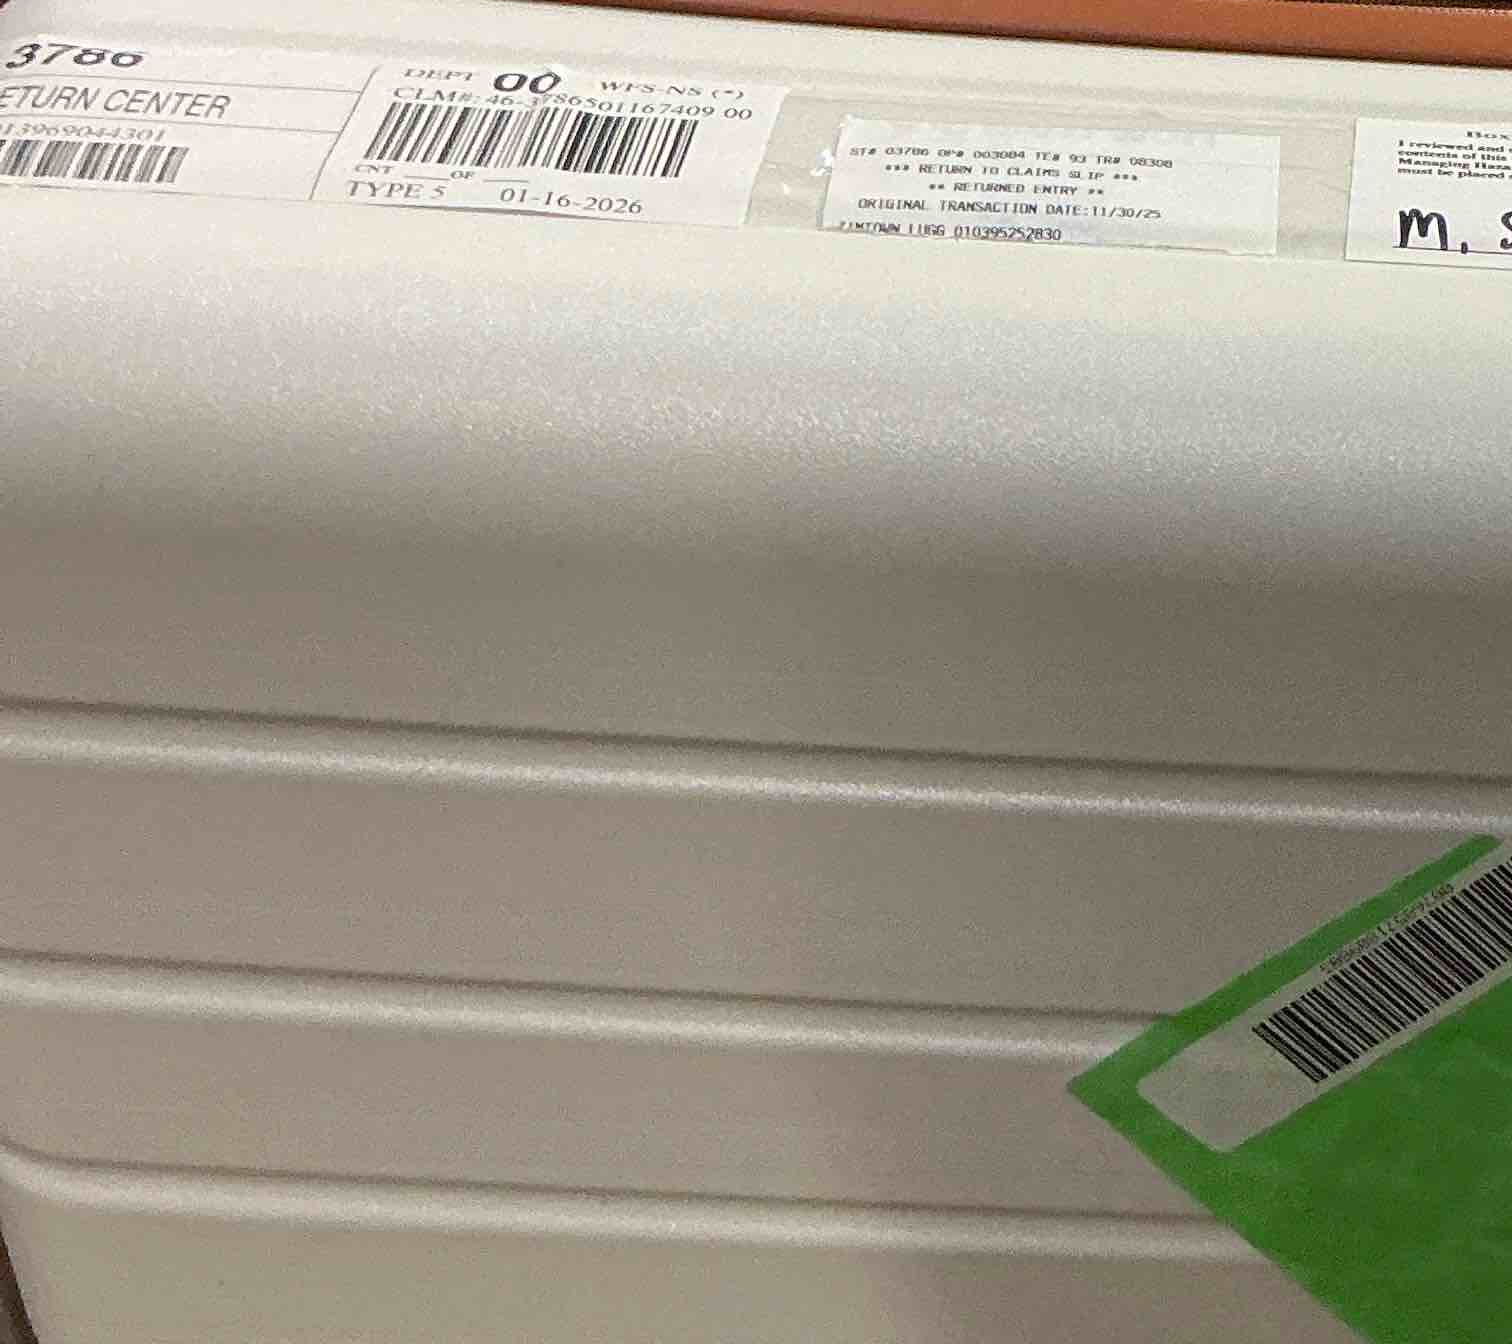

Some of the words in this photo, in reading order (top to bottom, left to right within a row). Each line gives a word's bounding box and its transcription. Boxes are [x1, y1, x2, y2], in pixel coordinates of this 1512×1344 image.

[5, 42, 147, 69] 3786
[403, 68, 474, 81] DEPT
[493, 71, 561, 94] 00
[0, 85, 100, 112] ETURN
[103, 89, 231, 119] CENTER
[724, 107, 753, 120] 00
[1409, 142, 1473, 151] reviewed
[1478, 145, 1504, 153] and
[1398, 150, 1458, 158] contents
[1462, 152, 1477, 160] of
[1481, 154, 1507, 162] this
[1399, 158, 1471, 169] Managing
[355, 164, 394, 176] CNT
[450, 171, 476, 180] OF
[919, 164, 972, 175] RETURN
[983, 166, 999, 175] TO
[1007, 167, 1060, 178] CLAIMS
[1069, 171, 1104, 181] SLIP
[1398, 167, 1432, 175] must
[1438, 168, 1454, 176] be
[1458, 170, 1504, 179] placed
[953, 182, 1025, 194] RETURNED
[1034, 184, 1078, 195] ENTRY
[349, 180, 424, 199] TYPE
[432, 185, 449, 199] 5
[500, 188, 643, 214] 01-16-2026
[858, 198, 927, 211] ORIGINAL
[939, 200, 1038, 215] TRANSACTION
[954, 226, 1061, 242] 010395252830
